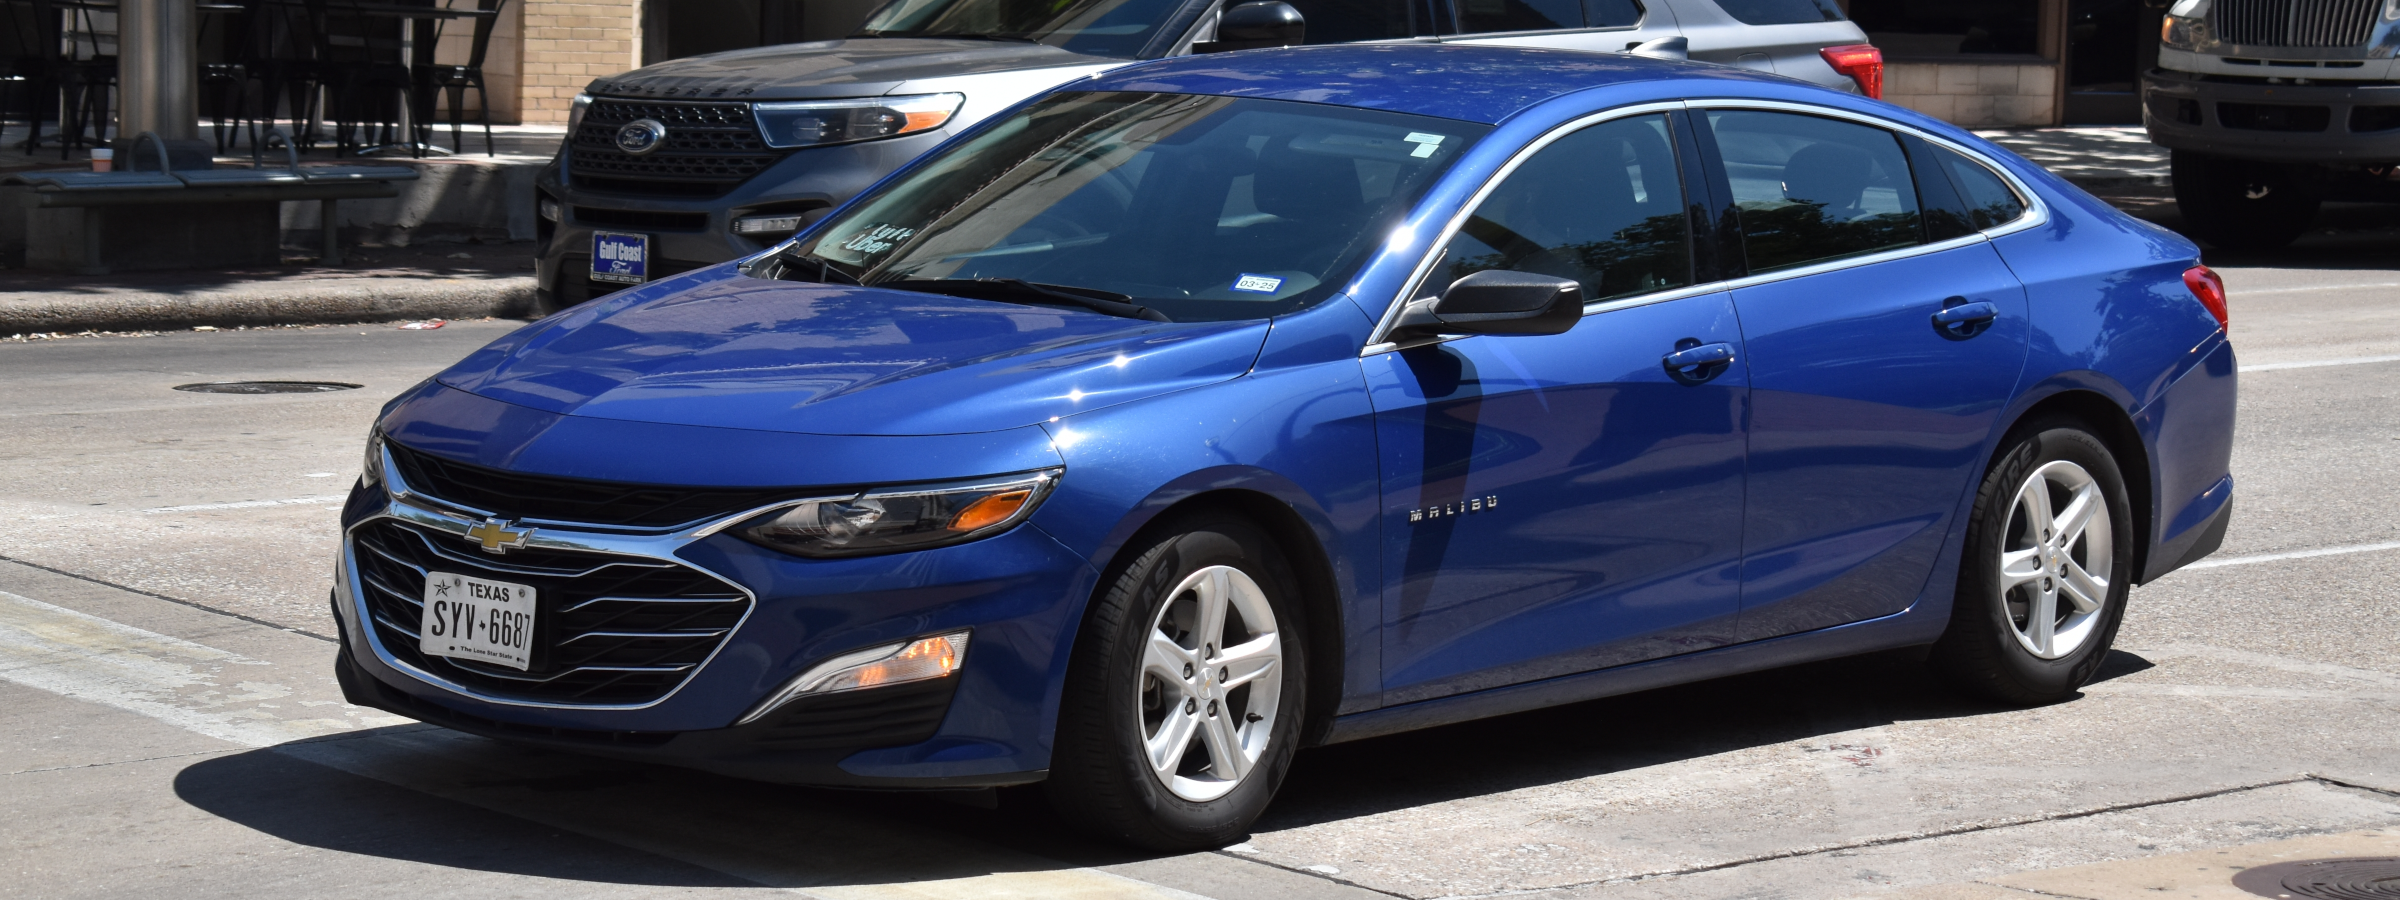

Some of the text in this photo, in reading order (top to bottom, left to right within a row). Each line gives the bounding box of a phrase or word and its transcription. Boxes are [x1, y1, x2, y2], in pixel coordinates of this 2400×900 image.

[601, 84, 754, 96] EXPLORER
[623, 130, 646, 145] Ford
[599, 240, 642, 262] Gulf Coast
[845, 233, 893, 253] Uber
[609, 260, 632, 275] Ford
[1409, 495, 1497, 521] MALIBU
[467, 581, 510, 603] TEXAS
[473, 647, 486, 655] Lone
[498, 652, 513, 660] State
